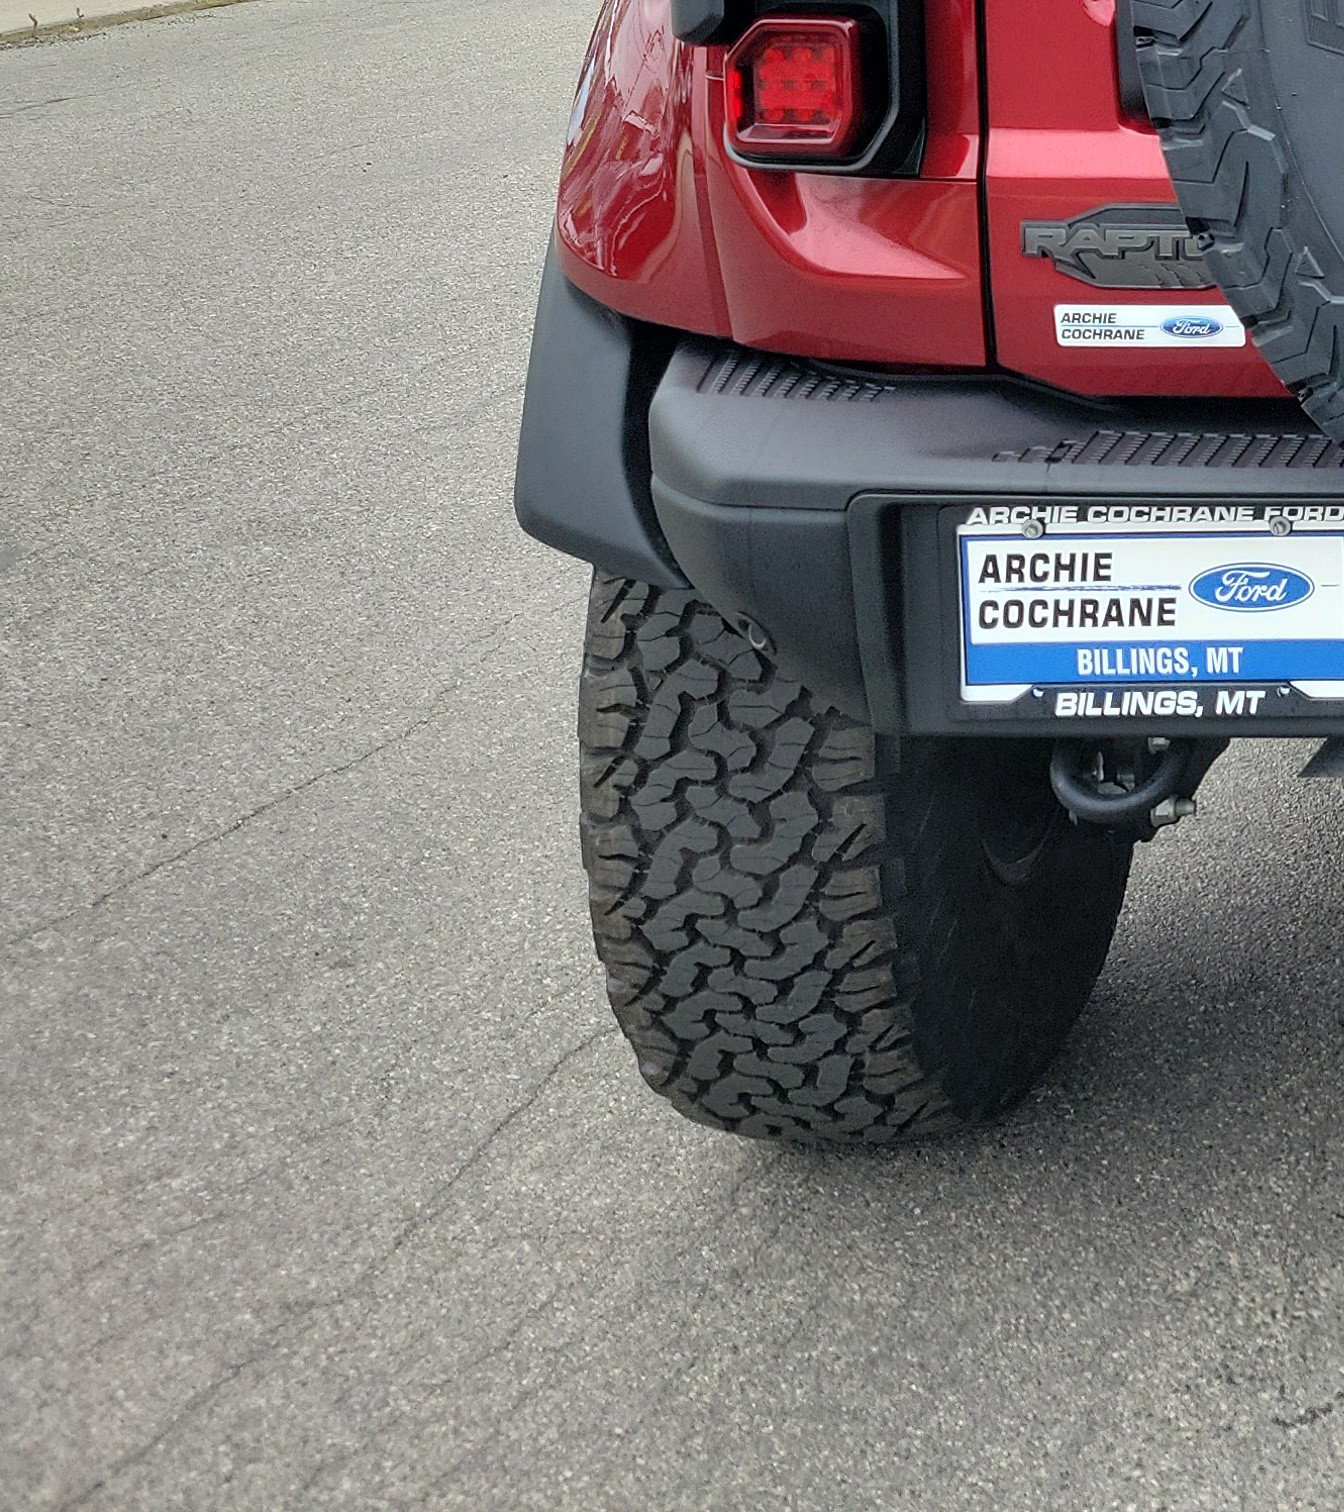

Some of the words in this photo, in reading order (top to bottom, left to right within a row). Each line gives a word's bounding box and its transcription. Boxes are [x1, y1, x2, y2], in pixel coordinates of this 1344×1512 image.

[1060, 312, 1117, 324] ARCHIE
[1171, 317, 1212, 336] Ford
[1061, 328, 1146, 341] COCHRANE
[967, 506, 1078, 525] ARCHIE
[1087, 505, 1254, 523] COCHRANE
[978, 551, 1113, 584] ARCHIE
[1213, 570, 1288, 604] Ford
[978, 597, 1177, 630] COCHRANE
[1077, 647, 1198, 678] BILLINGS,
[1206, 647, 1244, 674] MT
[1055, 690, 1204, 717] BILLINGS,
[1214, 690, 1266, 715] MT
